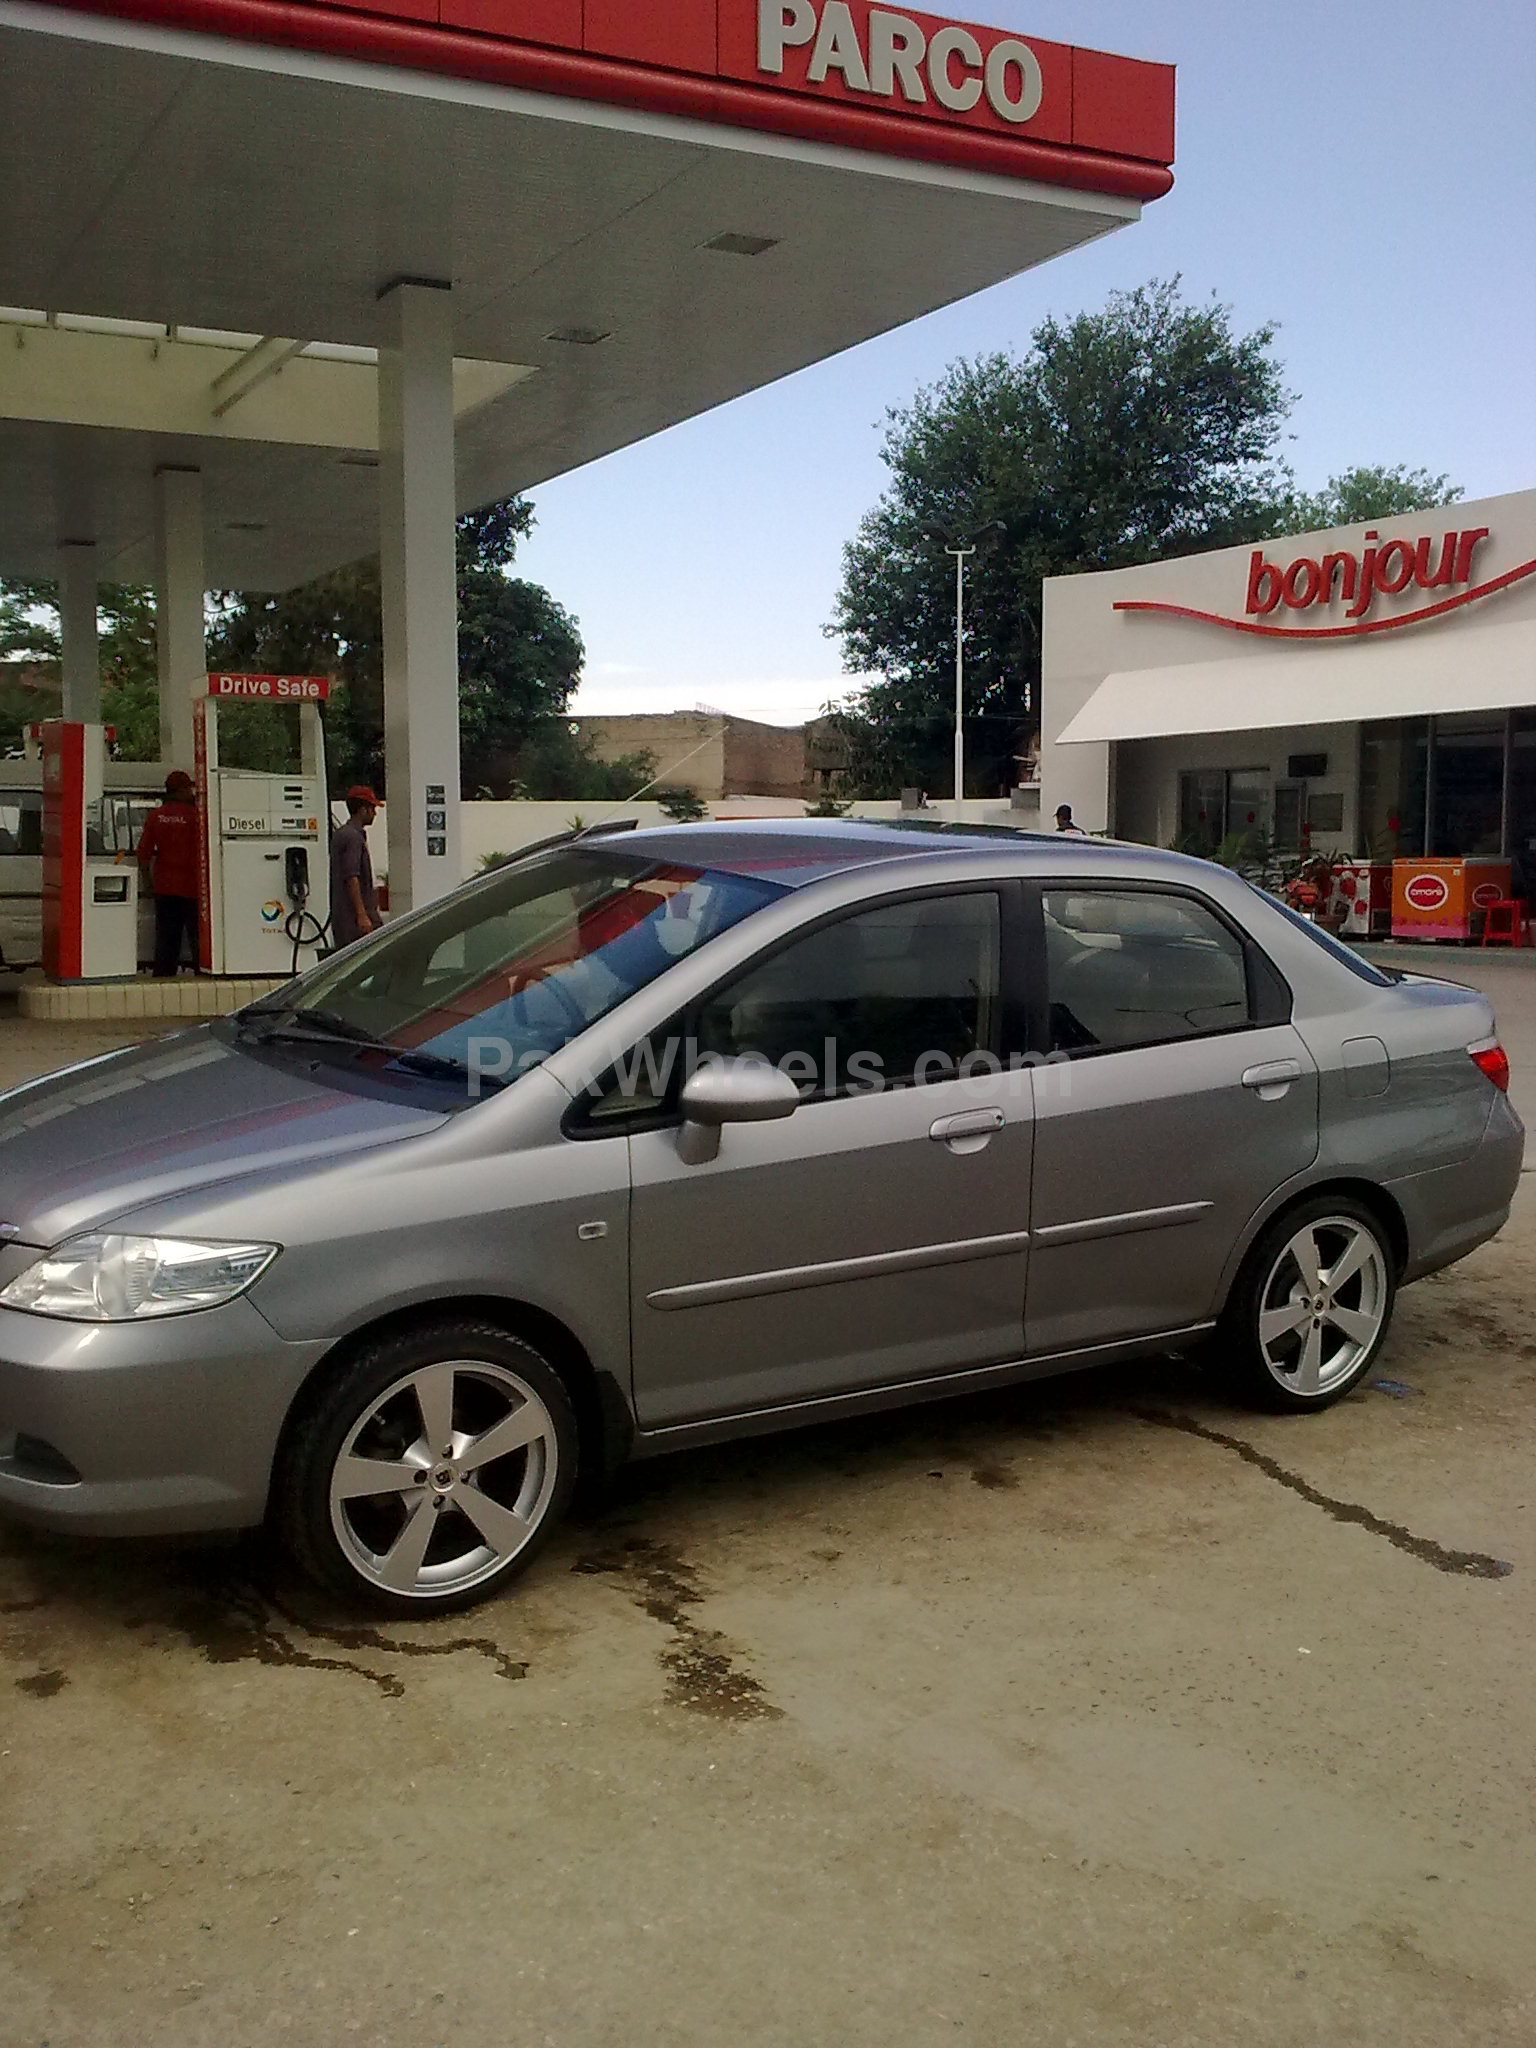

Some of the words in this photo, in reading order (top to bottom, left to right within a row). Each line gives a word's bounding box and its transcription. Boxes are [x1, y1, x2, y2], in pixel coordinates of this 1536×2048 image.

[757, 0, 1043, 123] PARCO
[1245, 527, 1489, 618] bonjour
[220, 677, 271, 695] Drive
[277, 679, 320, 696] Safe
[228, 817, 265, 830] Diesel
